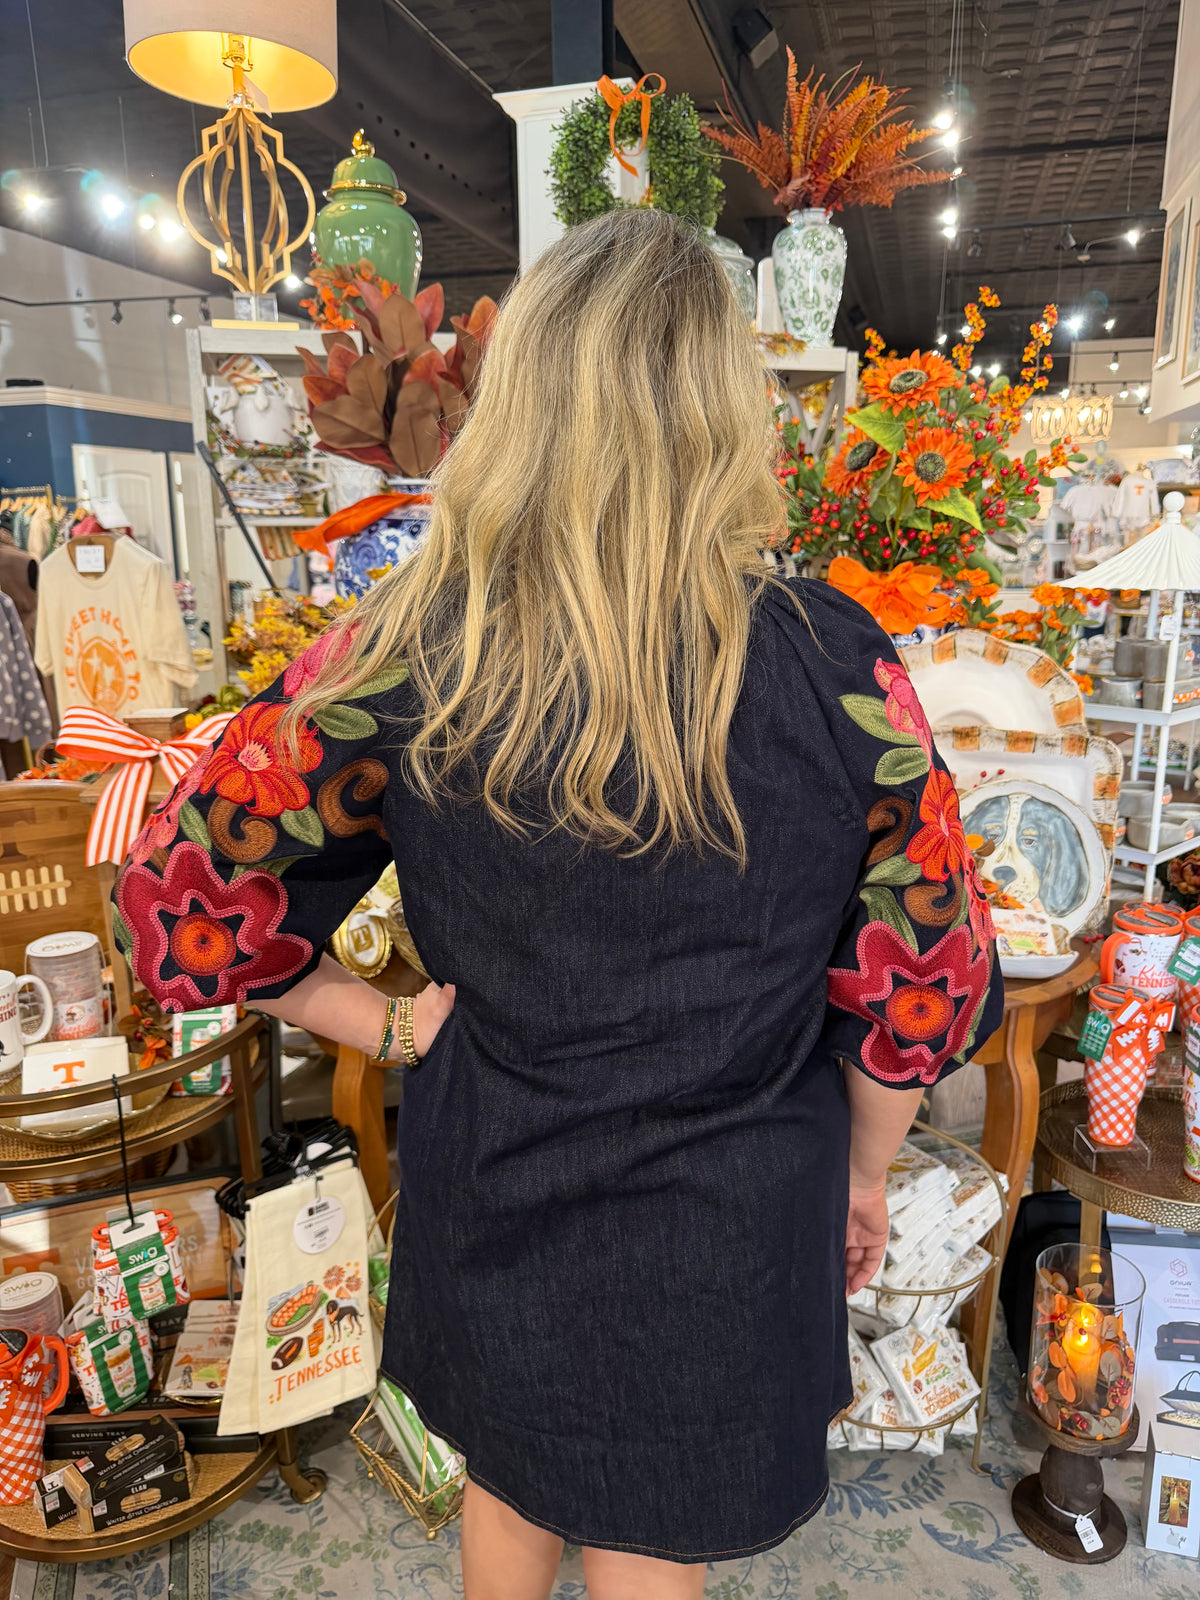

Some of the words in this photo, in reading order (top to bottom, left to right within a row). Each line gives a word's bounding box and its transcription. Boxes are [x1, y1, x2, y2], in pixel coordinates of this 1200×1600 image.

[1129, 975, 1178, 989] TENNES
[53, 1060, 86, 1084] T
[273, 1345, 362, 1402] TENNESSEE
